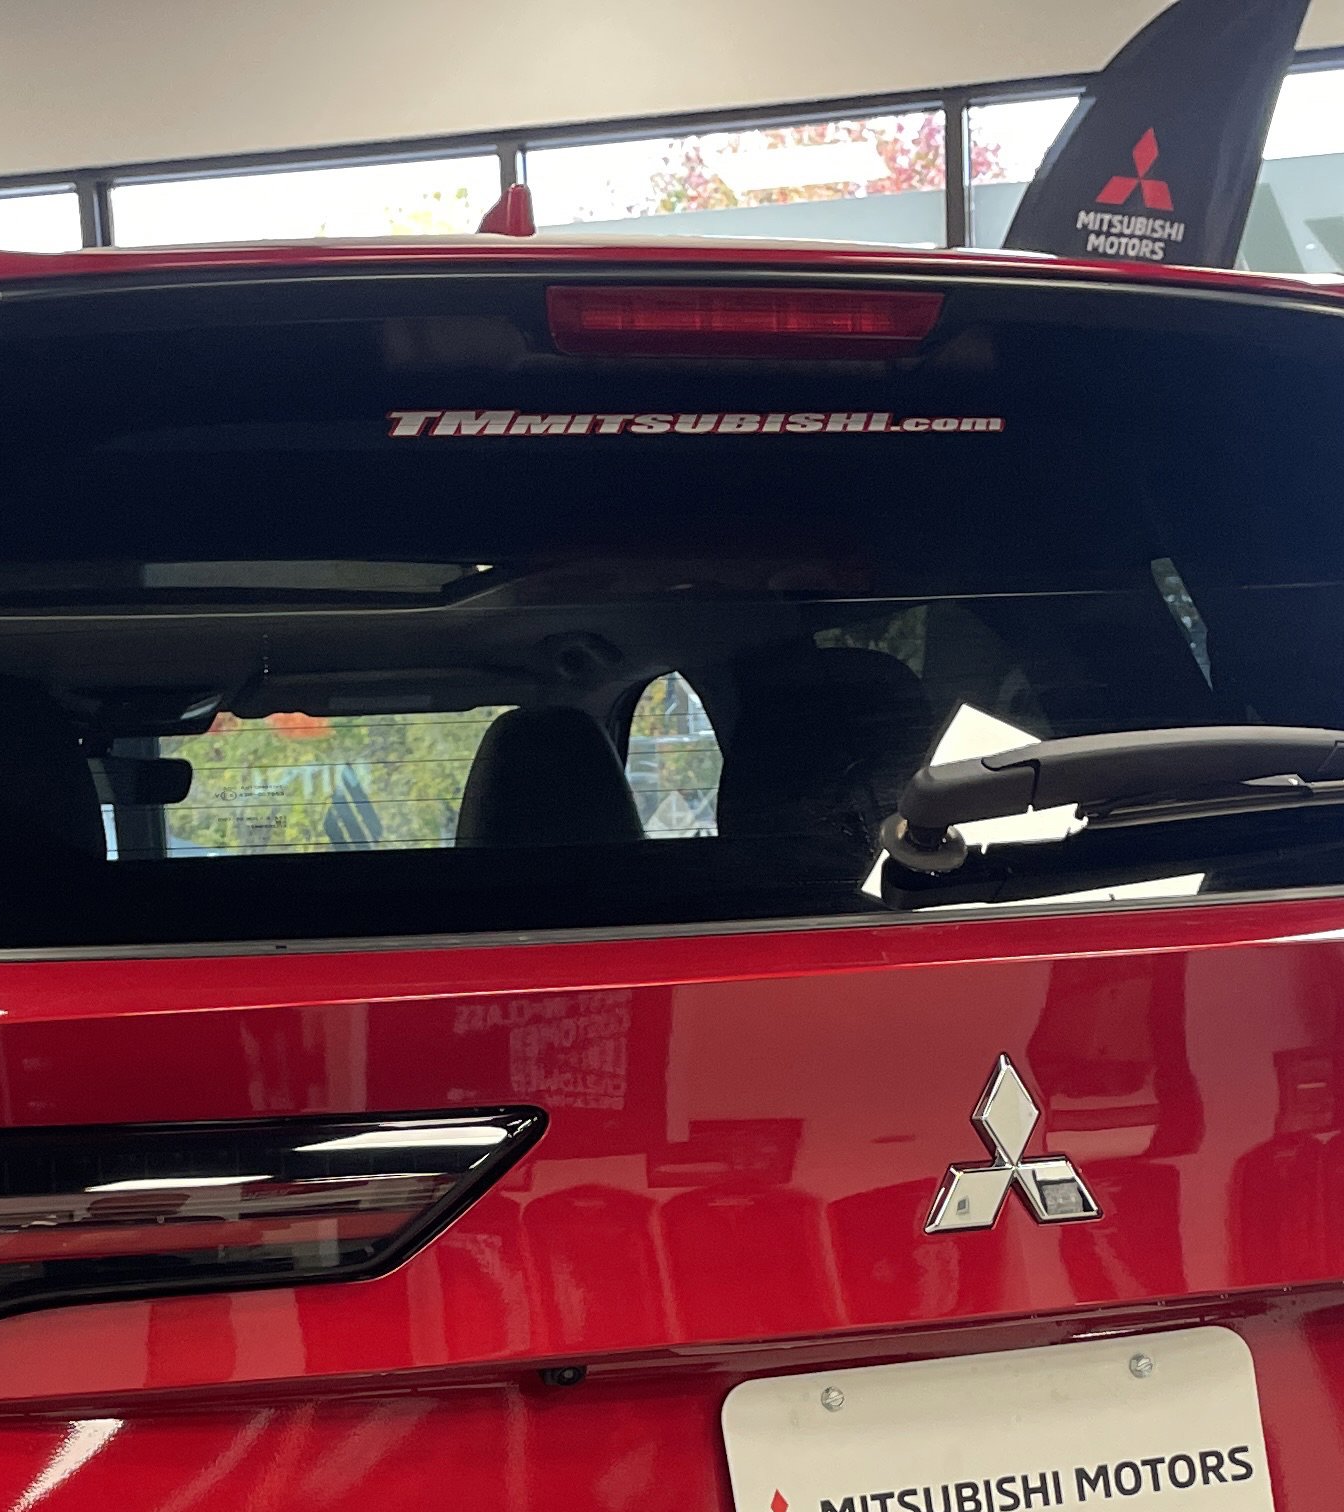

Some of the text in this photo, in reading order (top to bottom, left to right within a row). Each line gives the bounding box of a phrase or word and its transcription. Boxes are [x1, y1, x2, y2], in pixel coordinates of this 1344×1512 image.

[1076, 210, 1185, 243] MITSUBISHI
[1086, 233, 1167, 261] MOTORS
[1074, 1445, 1254, 1502] MOTORS
